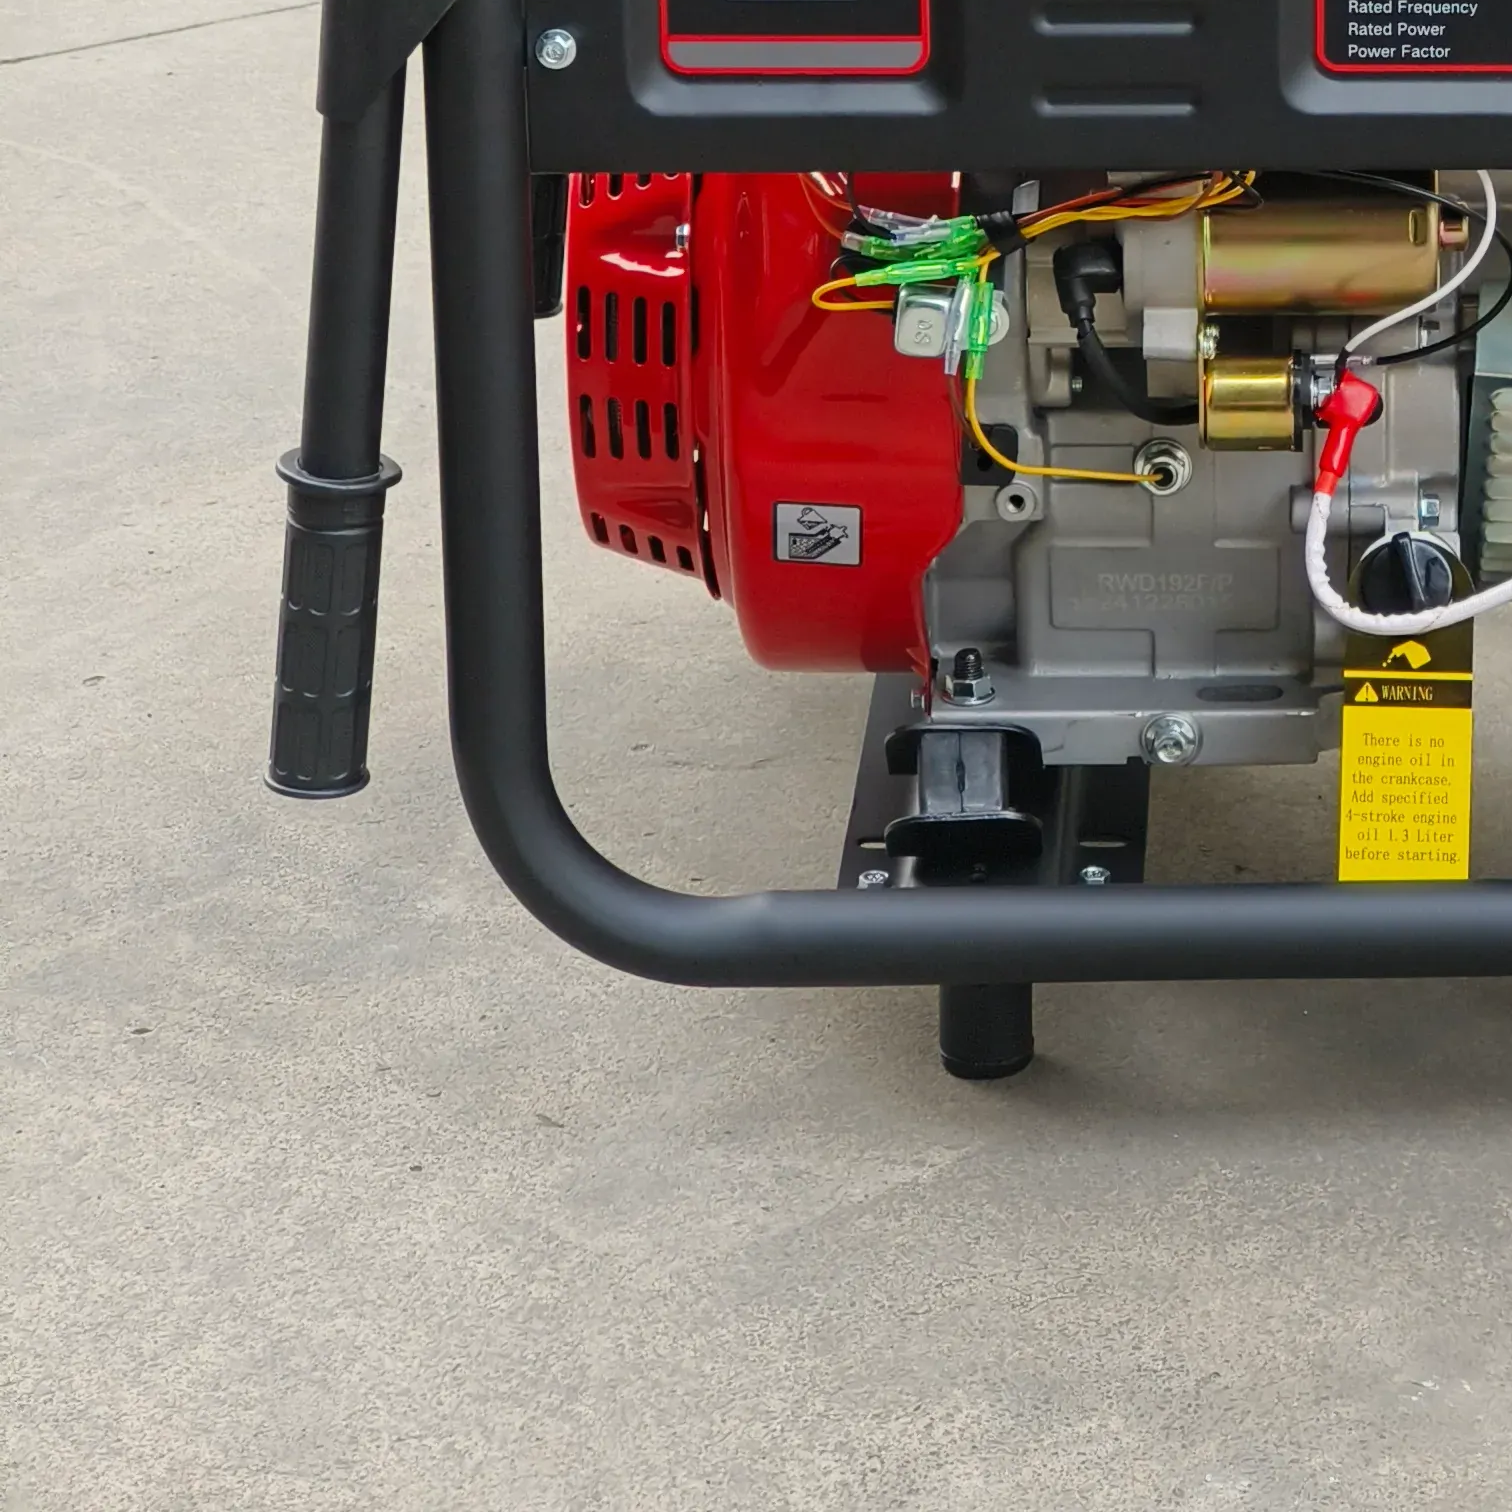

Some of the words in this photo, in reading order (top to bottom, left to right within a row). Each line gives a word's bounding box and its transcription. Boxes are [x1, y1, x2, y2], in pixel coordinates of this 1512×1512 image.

[1349, 0, 1393, 14] Rated
[1398, 0, 1478, 16] Frequency
[1349, 23, 1393, 36] Rated
[1397, 23, 1445, 36] Power
[1348, 45, 1396, 59] Power
[1401, 45, 1451, 59] Factor
[1381, 685, 1433, 701] WARNING
[1363, 733, 1400, 747] There
[1409, 734, 1422, 747] is
[1430, 737, 1445, 748] no
[1358, 754, 1403, 768] engine
[1410, 754, 1431, 766] oil
[1441, 755, 1455, 767] in
[1352, 772, 1373, 784] the
[1381, 772, 1452, 786] crankcase.
[1351, 790, 1374, 803] Add
[1382, 792, 1449, 806] specified
[1345, 809, 1405, 822] 4-stroke
[1413, 811, 1457, 825] engine
[1357, 829, 1378, 841] oil
[1389, 829, 1409, 842] 1.3
[1417, 829, 1455, 843] Liter
[1345, 847, 1390, 861] before
[1397, 848, 1461, 864] starting.
